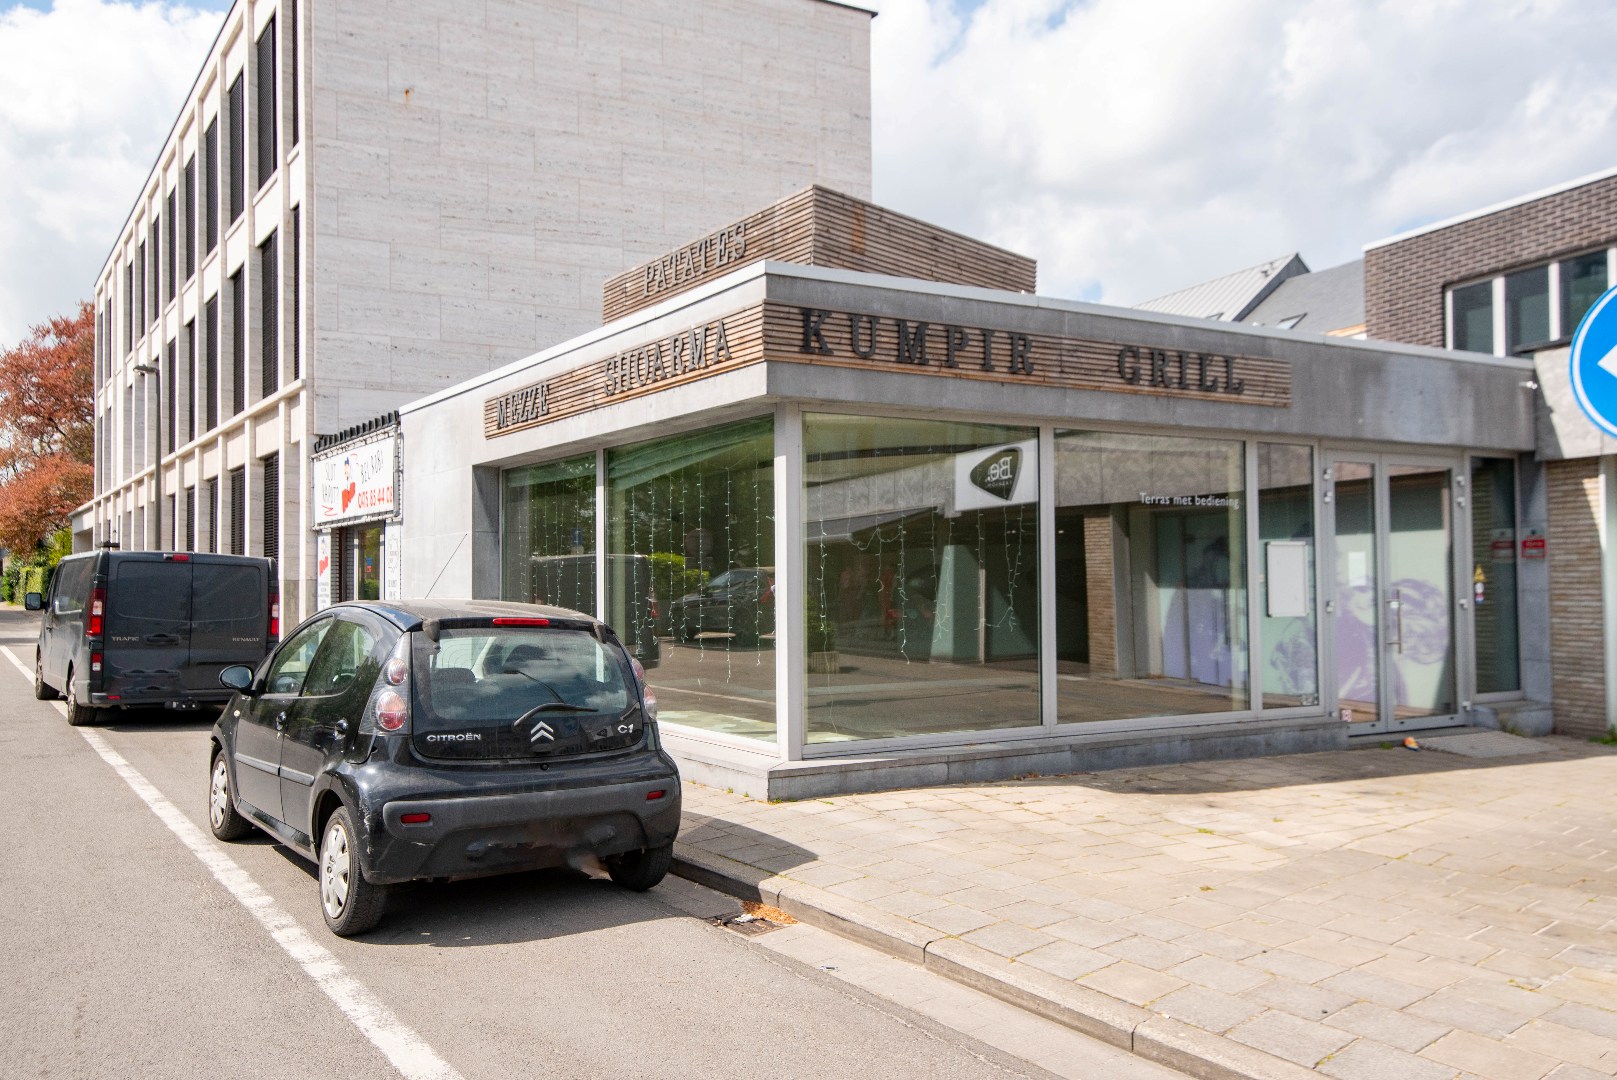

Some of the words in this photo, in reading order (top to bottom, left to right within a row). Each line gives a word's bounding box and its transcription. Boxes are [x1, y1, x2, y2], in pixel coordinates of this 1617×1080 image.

[643, 221, 748, 298] PATATES
[496, 381, 550, 430] MEZZE
[603, 318, 732, 396] SHOARMA
[800, 307, 1034, 375] KUMPIR
[1118, 344, 1245, 394] GRILL
[1140, 492, 1170, 504] Terras
[1173, 496, 1192, 505] met
[1195, 494, 1240, 510] bediening
[426, 732, 481, 742] CITROËN
[617, 723, 634, 734] C1
